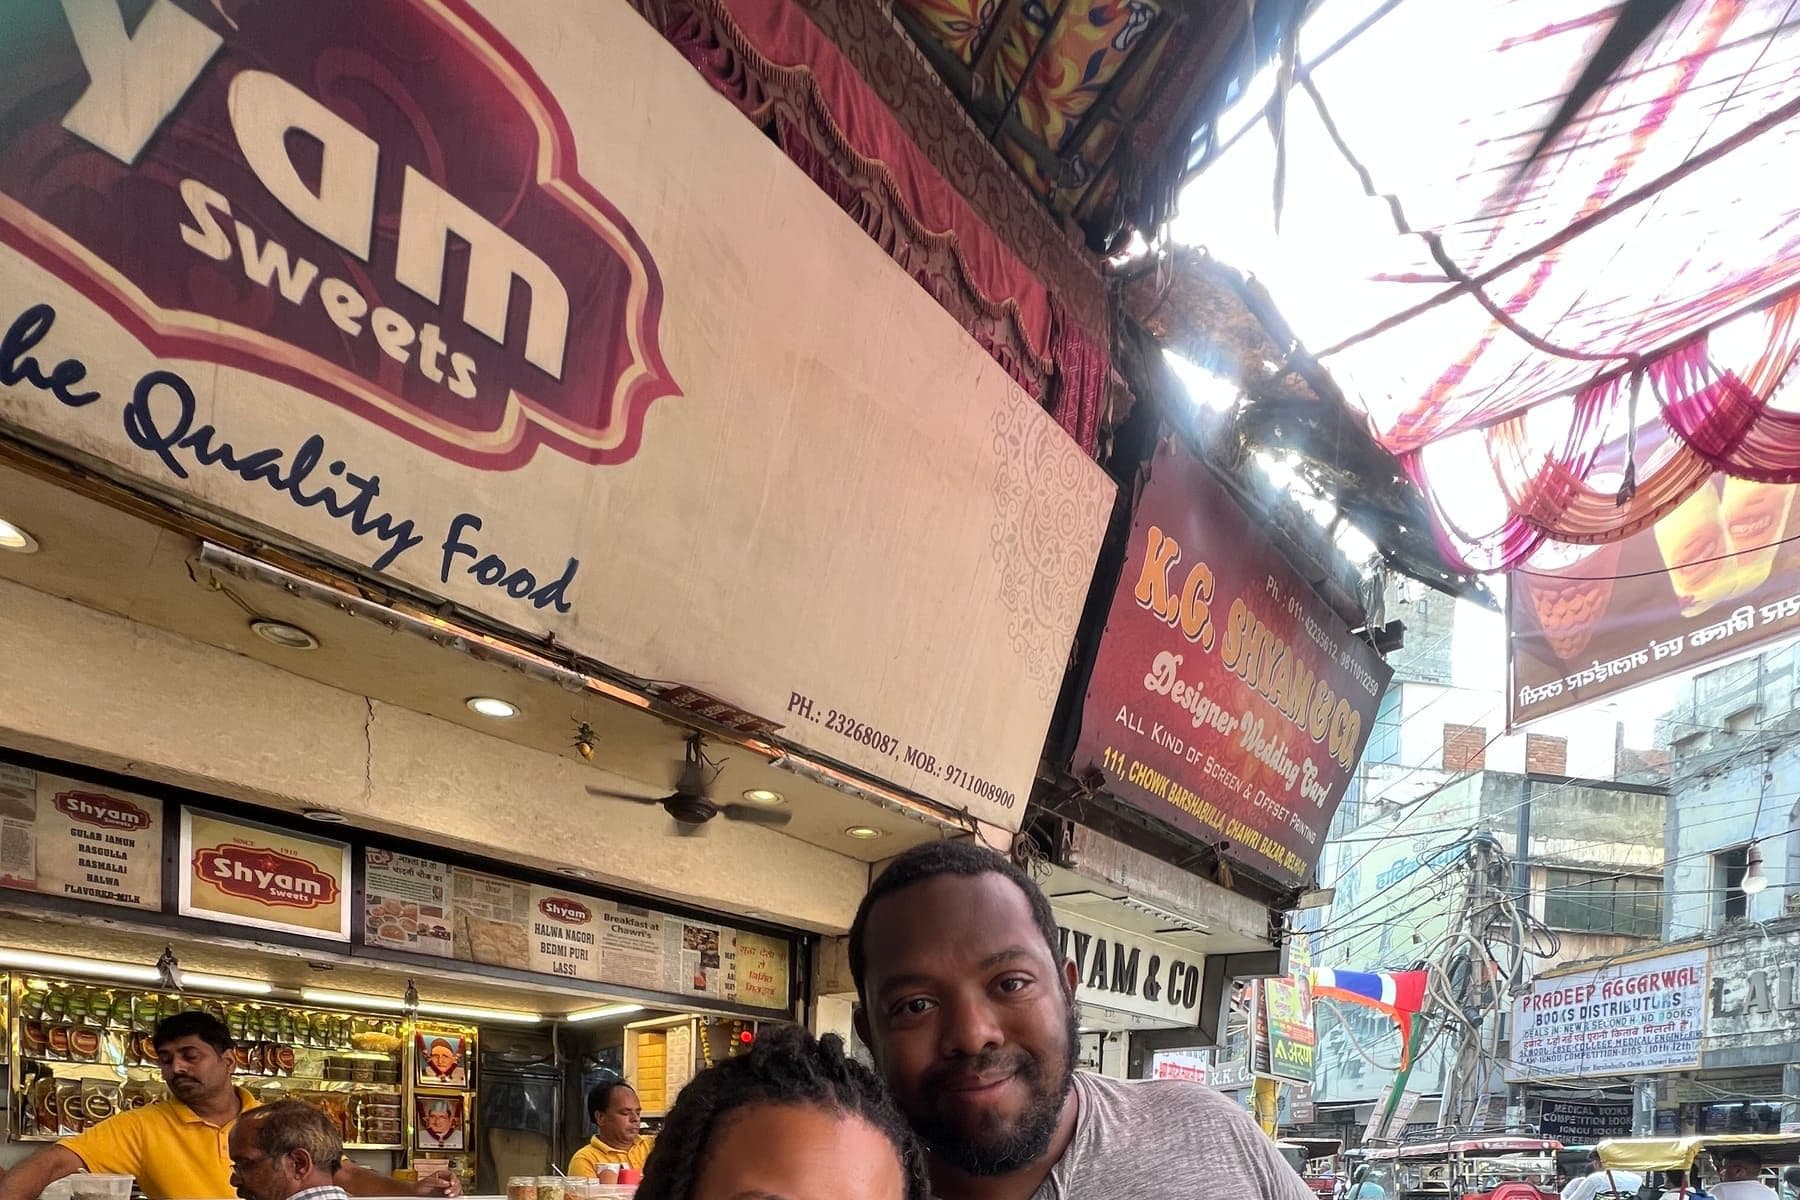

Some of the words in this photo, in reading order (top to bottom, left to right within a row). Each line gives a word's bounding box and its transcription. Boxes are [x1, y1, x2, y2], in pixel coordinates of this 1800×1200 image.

[179, 177, 478, 399] Sweets
[123, 370, 424, 571] Quality
[440, 513, 580, 614] Food
[1220, 598, 1316, 734] SHYAM
[1306, 680, 1336, 743] &
[1143, 651, 1240, 741] Designer
[1239, 711, 1302, 791] Wedding
[1300, 756, 1333, 810] Card
[824, 709, 900, 763] 23268087,
[902, 745, 943, 779] MOB.:
[943, 764, 1016, 810] 9711008900
[1114, 704, 1146, 738] ALL
[1150, 720, 1185, 758] KIND
[1203, 750, 1244, 795] SCREEN
[1242, 778, 1254, 802] &
[1253, 787, 1290, 824] OFFSET
[1102, 746, 1128, 785] 111,
[1128, 762, 1171, 802] CHOWK
[1225, 816, 1260, 854] CHAWRI
[66, 797, 140, 825] Shyam
[70, 827, 103, 843] GULAB
[104, 833, 136, 848] JAMUN
[231, 836, 256, 848] SINCE
[78, 843, 128, 861] RASGULLA
[78, 857, 128, 875] RASMALAI
[86, 873, 120, 887] HALWA
[213, 857, 322, 898] Shyam
[269, 886, 310, 903] Sweets
[545, 901, 587, 920] Shyam
[603, 912, 648, 930] Breakfast
[649, 922, 660, 932] at
[611, 923, 652, 940] Chawri's
[534, 922, 563, 941] HALWA
[563, 928, 595, 947] NAGORI
[539, 942, 567, 958] BEDMI
[567, 946, 589, 962] PURI
[552, 960, 577, 977] LASSI
[1143, 955, 1162, 1002] &
[1167, 960, 1199, 1010] CO
[1522, 983, 1596, 1013] PRADEEP
[1602, 966, 1699, 1000] AGGARWAL
[1563, 1019, 1584, 1034] NEW
[1590, 1016, 1628, 1031] SECOND
[1543, 1112, 1605, 1126] COMPETITION
[1553, 1103, 1595, 1115] MEDICAL
[1599, 1106, 1629, 1116] BOOKS
[1558, 1125, 1591, 1135] IGNOU
